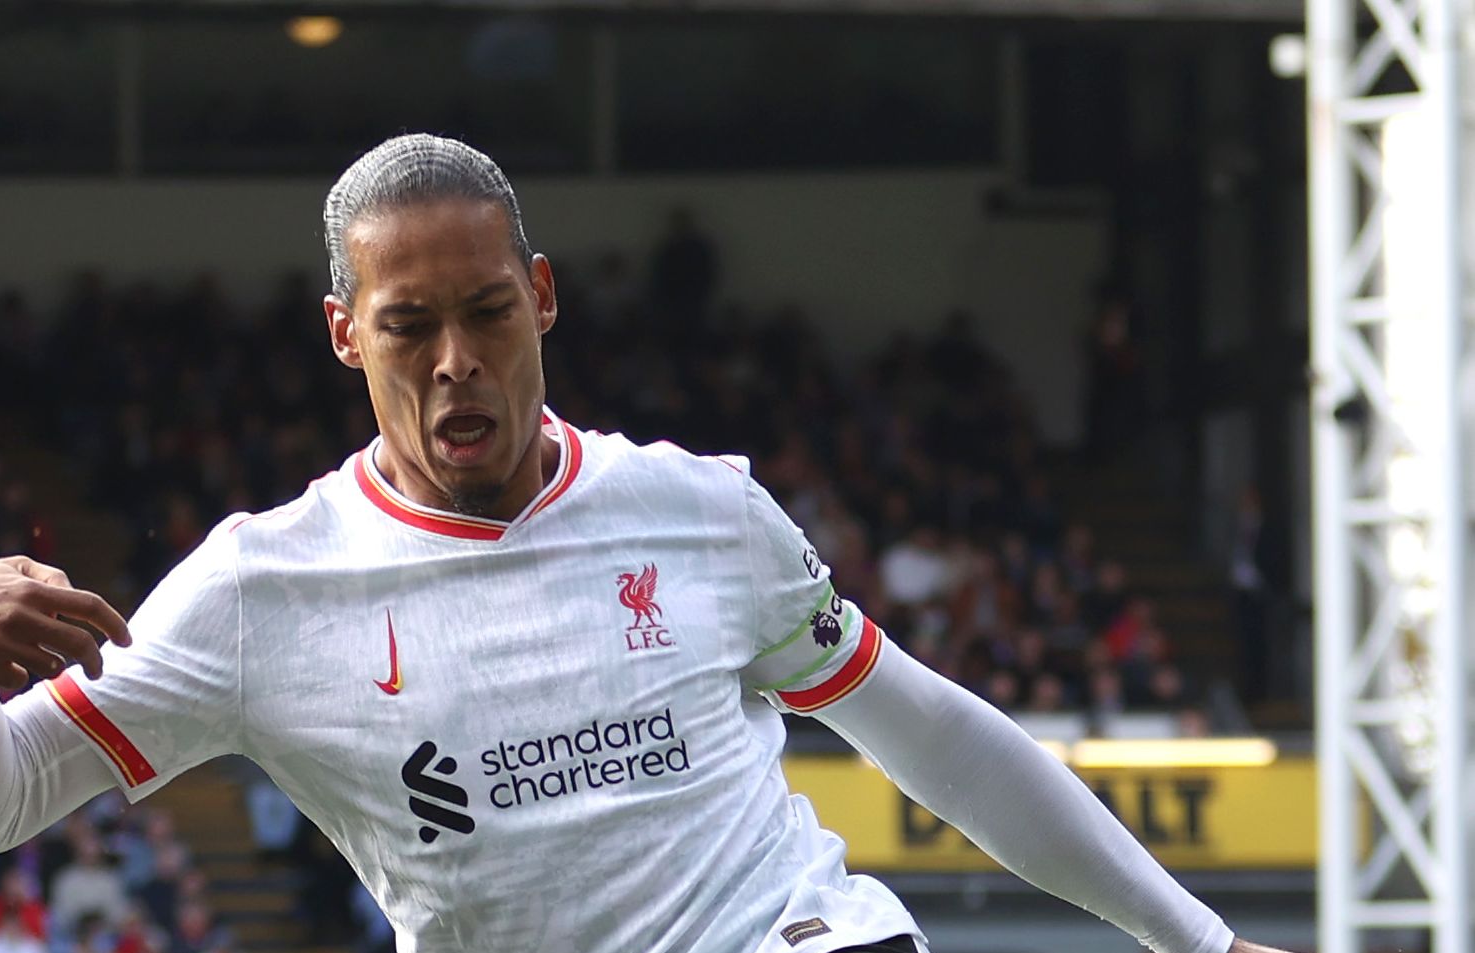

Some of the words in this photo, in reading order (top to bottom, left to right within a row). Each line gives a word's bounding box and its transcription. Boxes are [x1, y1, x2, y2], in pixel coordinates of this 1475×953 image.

[625, 629, 677, 651] L.F.C.
[481, 708, 676, 776] standard
[489, 740, 691, 809] chartered
